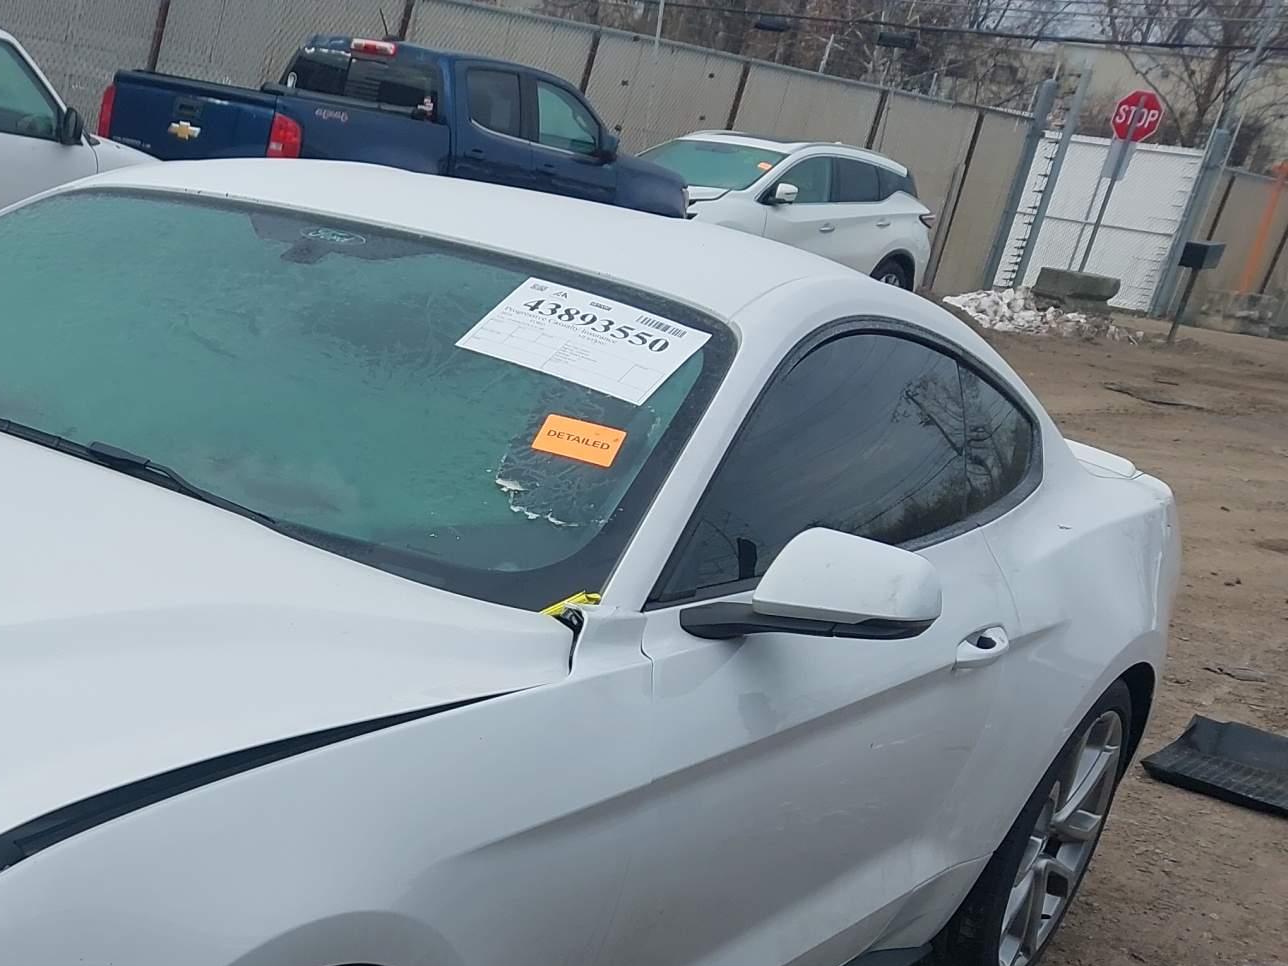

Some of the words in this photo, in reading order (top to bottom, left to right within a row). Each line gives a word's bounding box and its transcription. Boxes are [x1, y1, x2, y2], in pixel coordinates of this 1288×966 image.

[1115, 104, 1159, 128] STOP
[523, 299, 670, 352] 43893550
[547, 429, 611, 451] DETAILED
